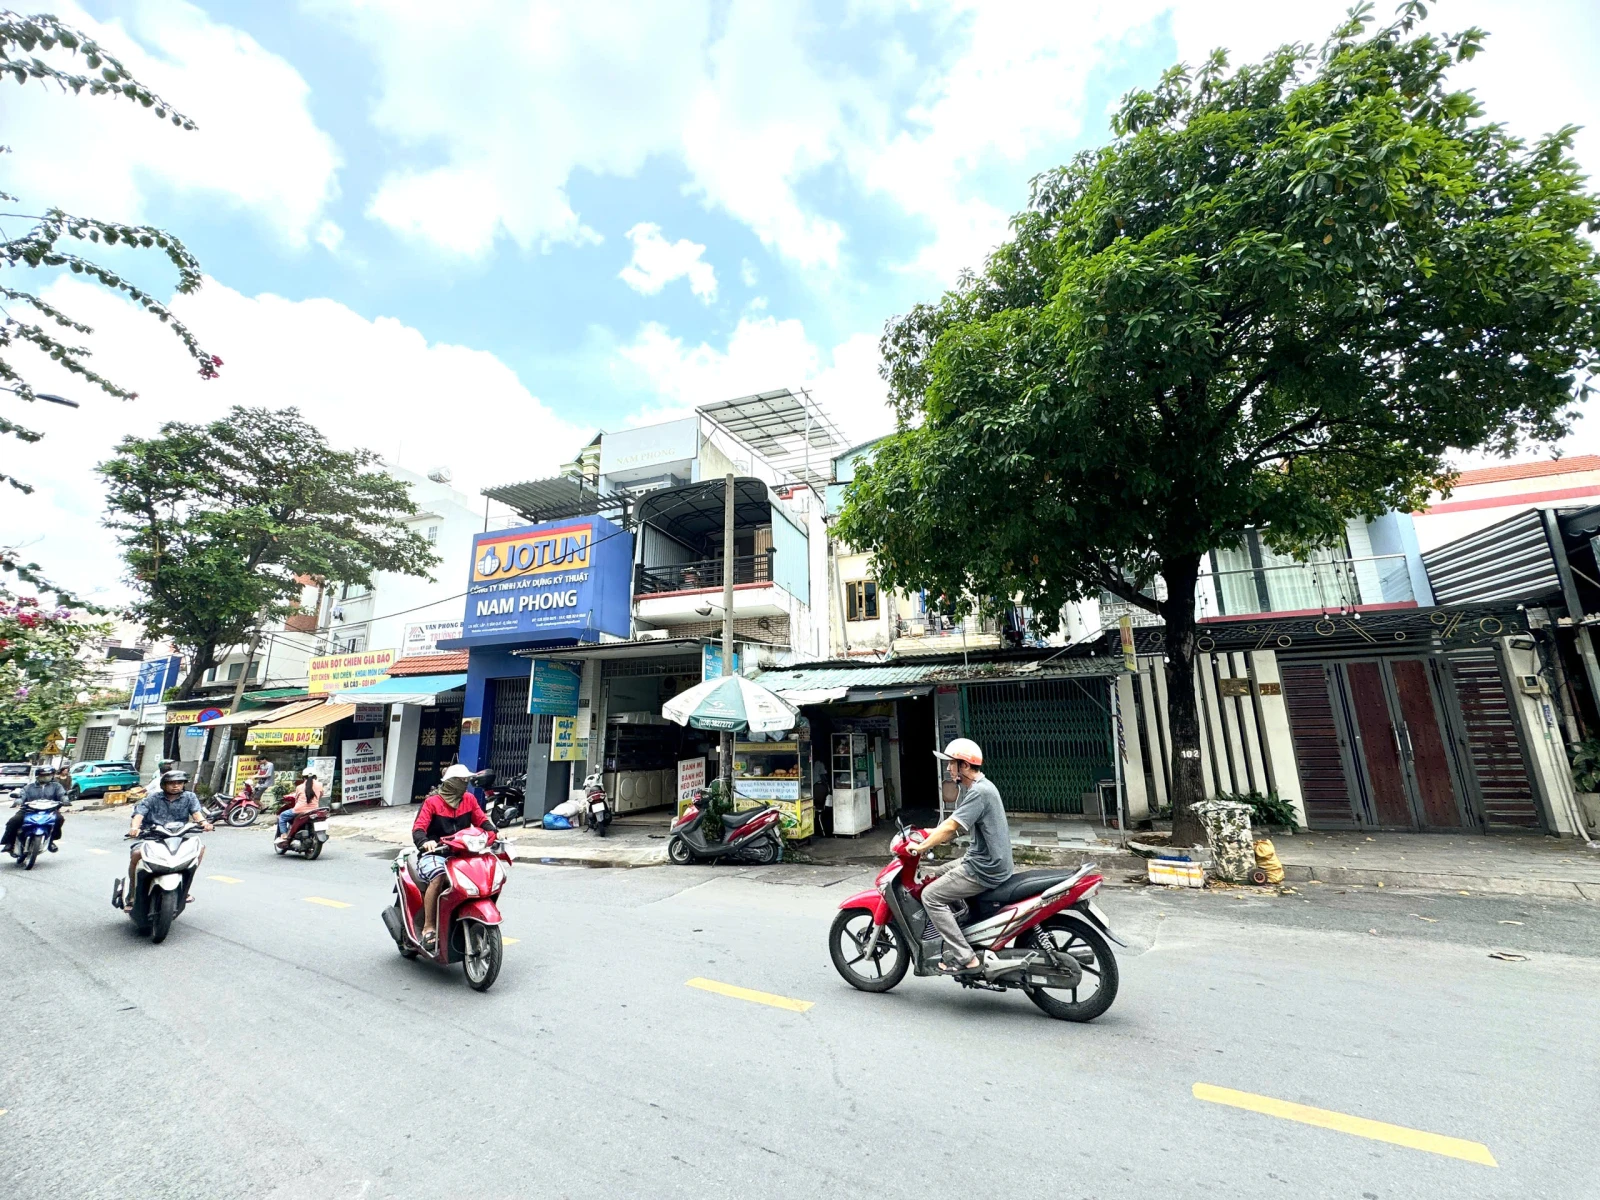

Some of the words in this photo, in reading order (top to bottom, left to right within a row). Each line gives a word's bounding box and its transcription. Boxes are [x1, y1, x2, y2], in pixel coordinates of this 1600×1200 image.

[617, 455, 638, 465] NAM
[641, 448, 676, 460] PHONG
[502, 535, 587, 572] JOTUN
[489, 584, 497, 593] TY
[499, 582, 516, 592] TNHH
[476, 597, 515, 618] NAM
[518, 589, 578, 613] PHONG
[363, 655, 375, 665] GIA
[283, 733, 294, 742] GIA
[1181, 750, 1200, 759] 102
[691, 779, 704, 788] QUAY
